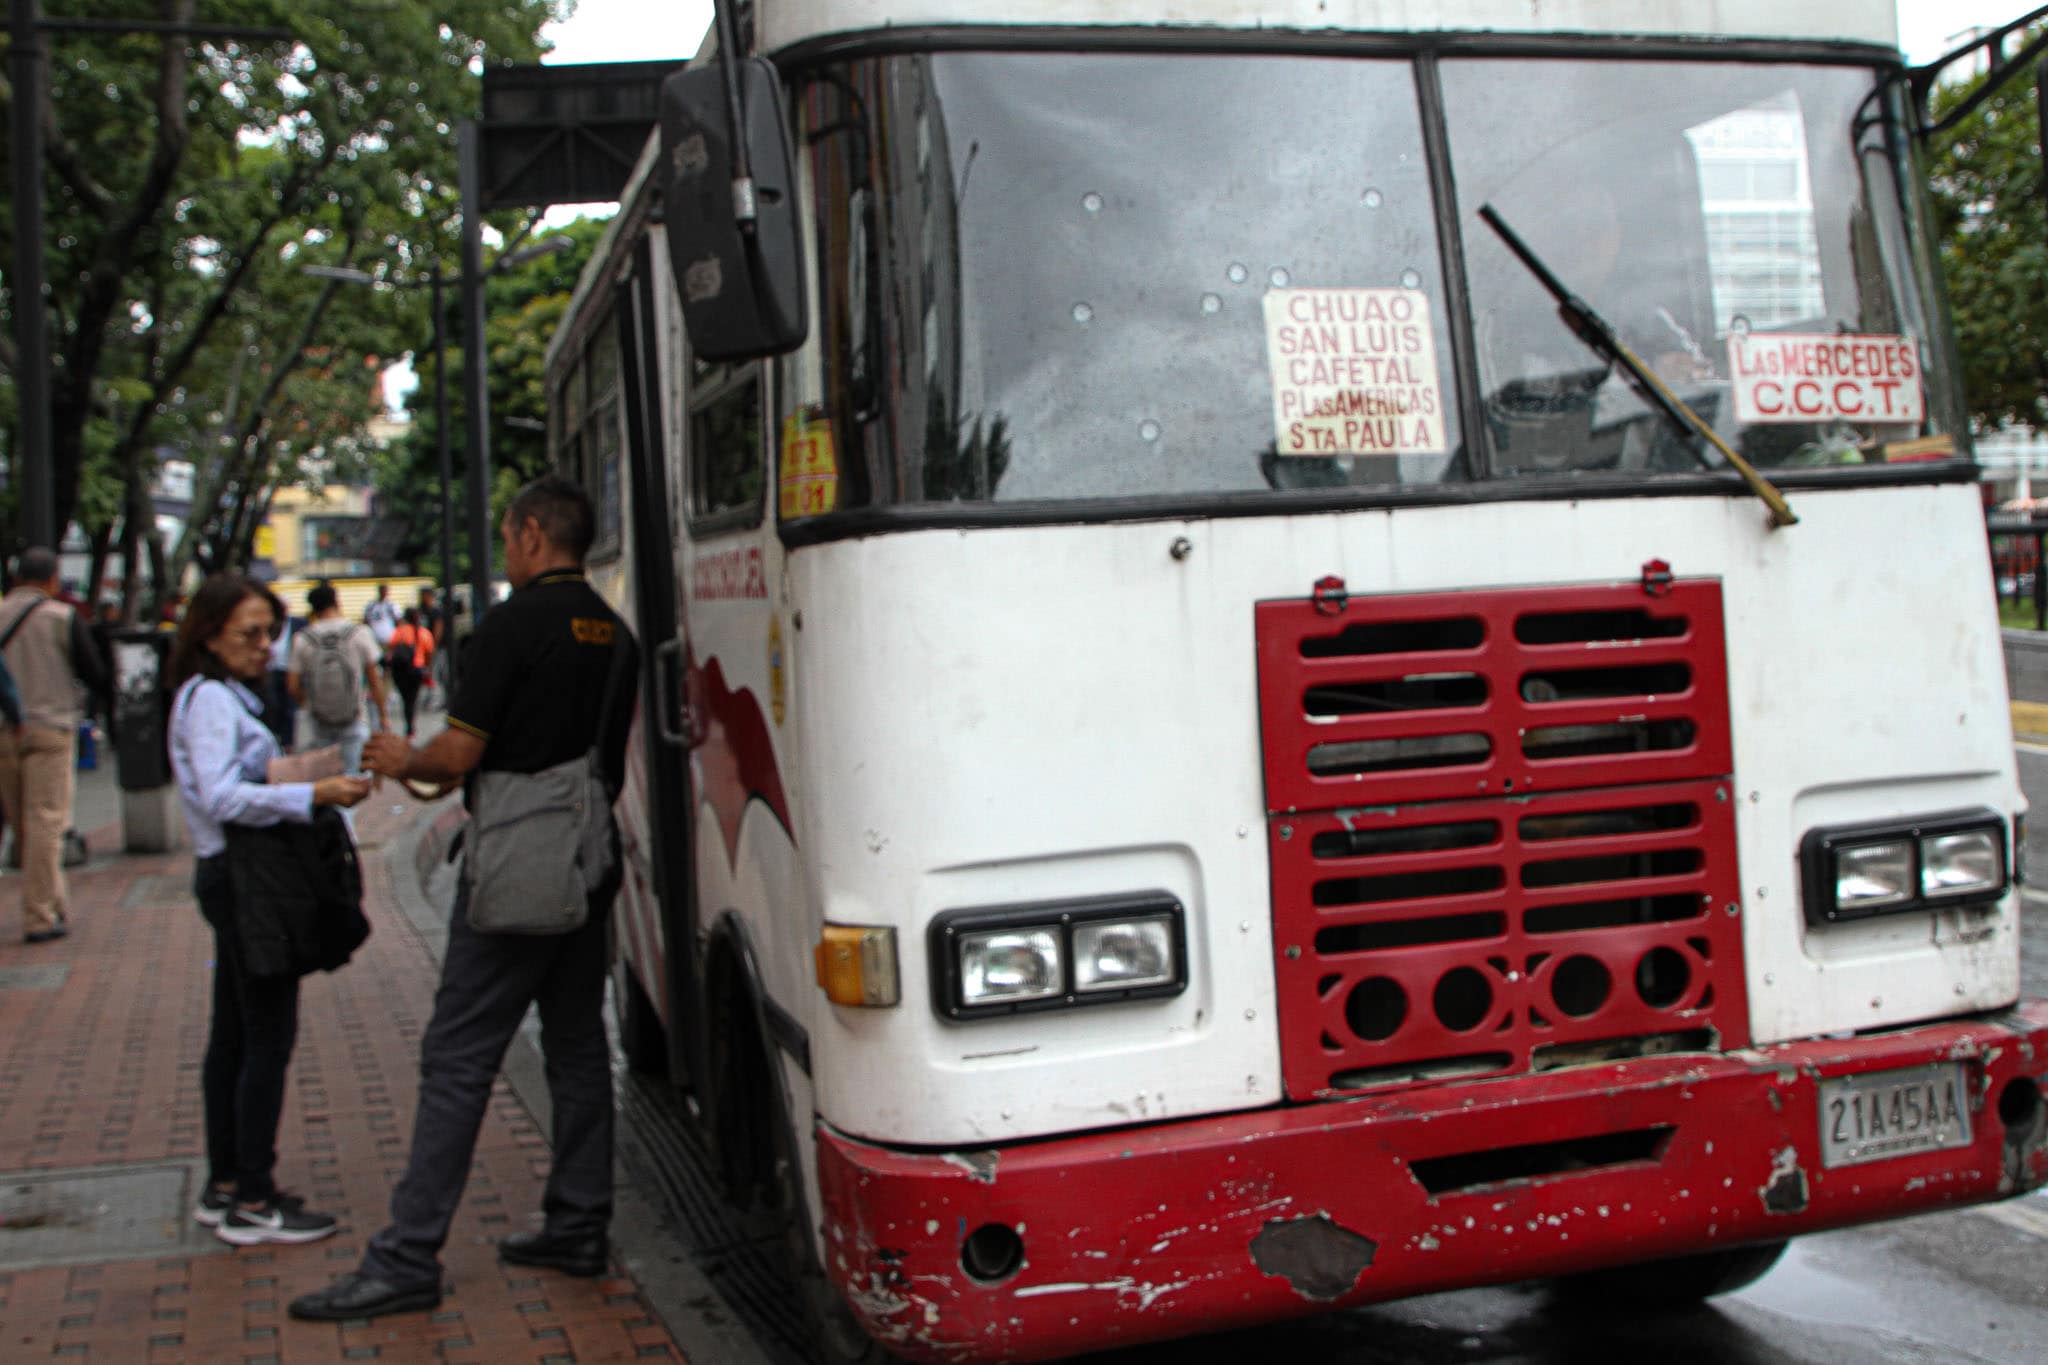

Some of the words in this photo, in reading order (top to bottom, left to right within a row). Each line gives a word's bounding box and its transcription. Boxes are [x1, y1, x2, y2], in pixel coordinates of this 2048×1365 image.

[1287, 295, 1414, 323] CHUAO
[1278, 326, 1340, 354] SAN
[1351, 326, 1422, 353] LUIS
[1288, 357, 1423, 385] CAFETAL
[1780, 341, 1915, 378] MERCEDES
[1752, 380, 1910, 415] C.C.C.T.
[1344, 418, 1432, 449] PAULA
[1830, 1079, 1962, 1144] 21A45AA
